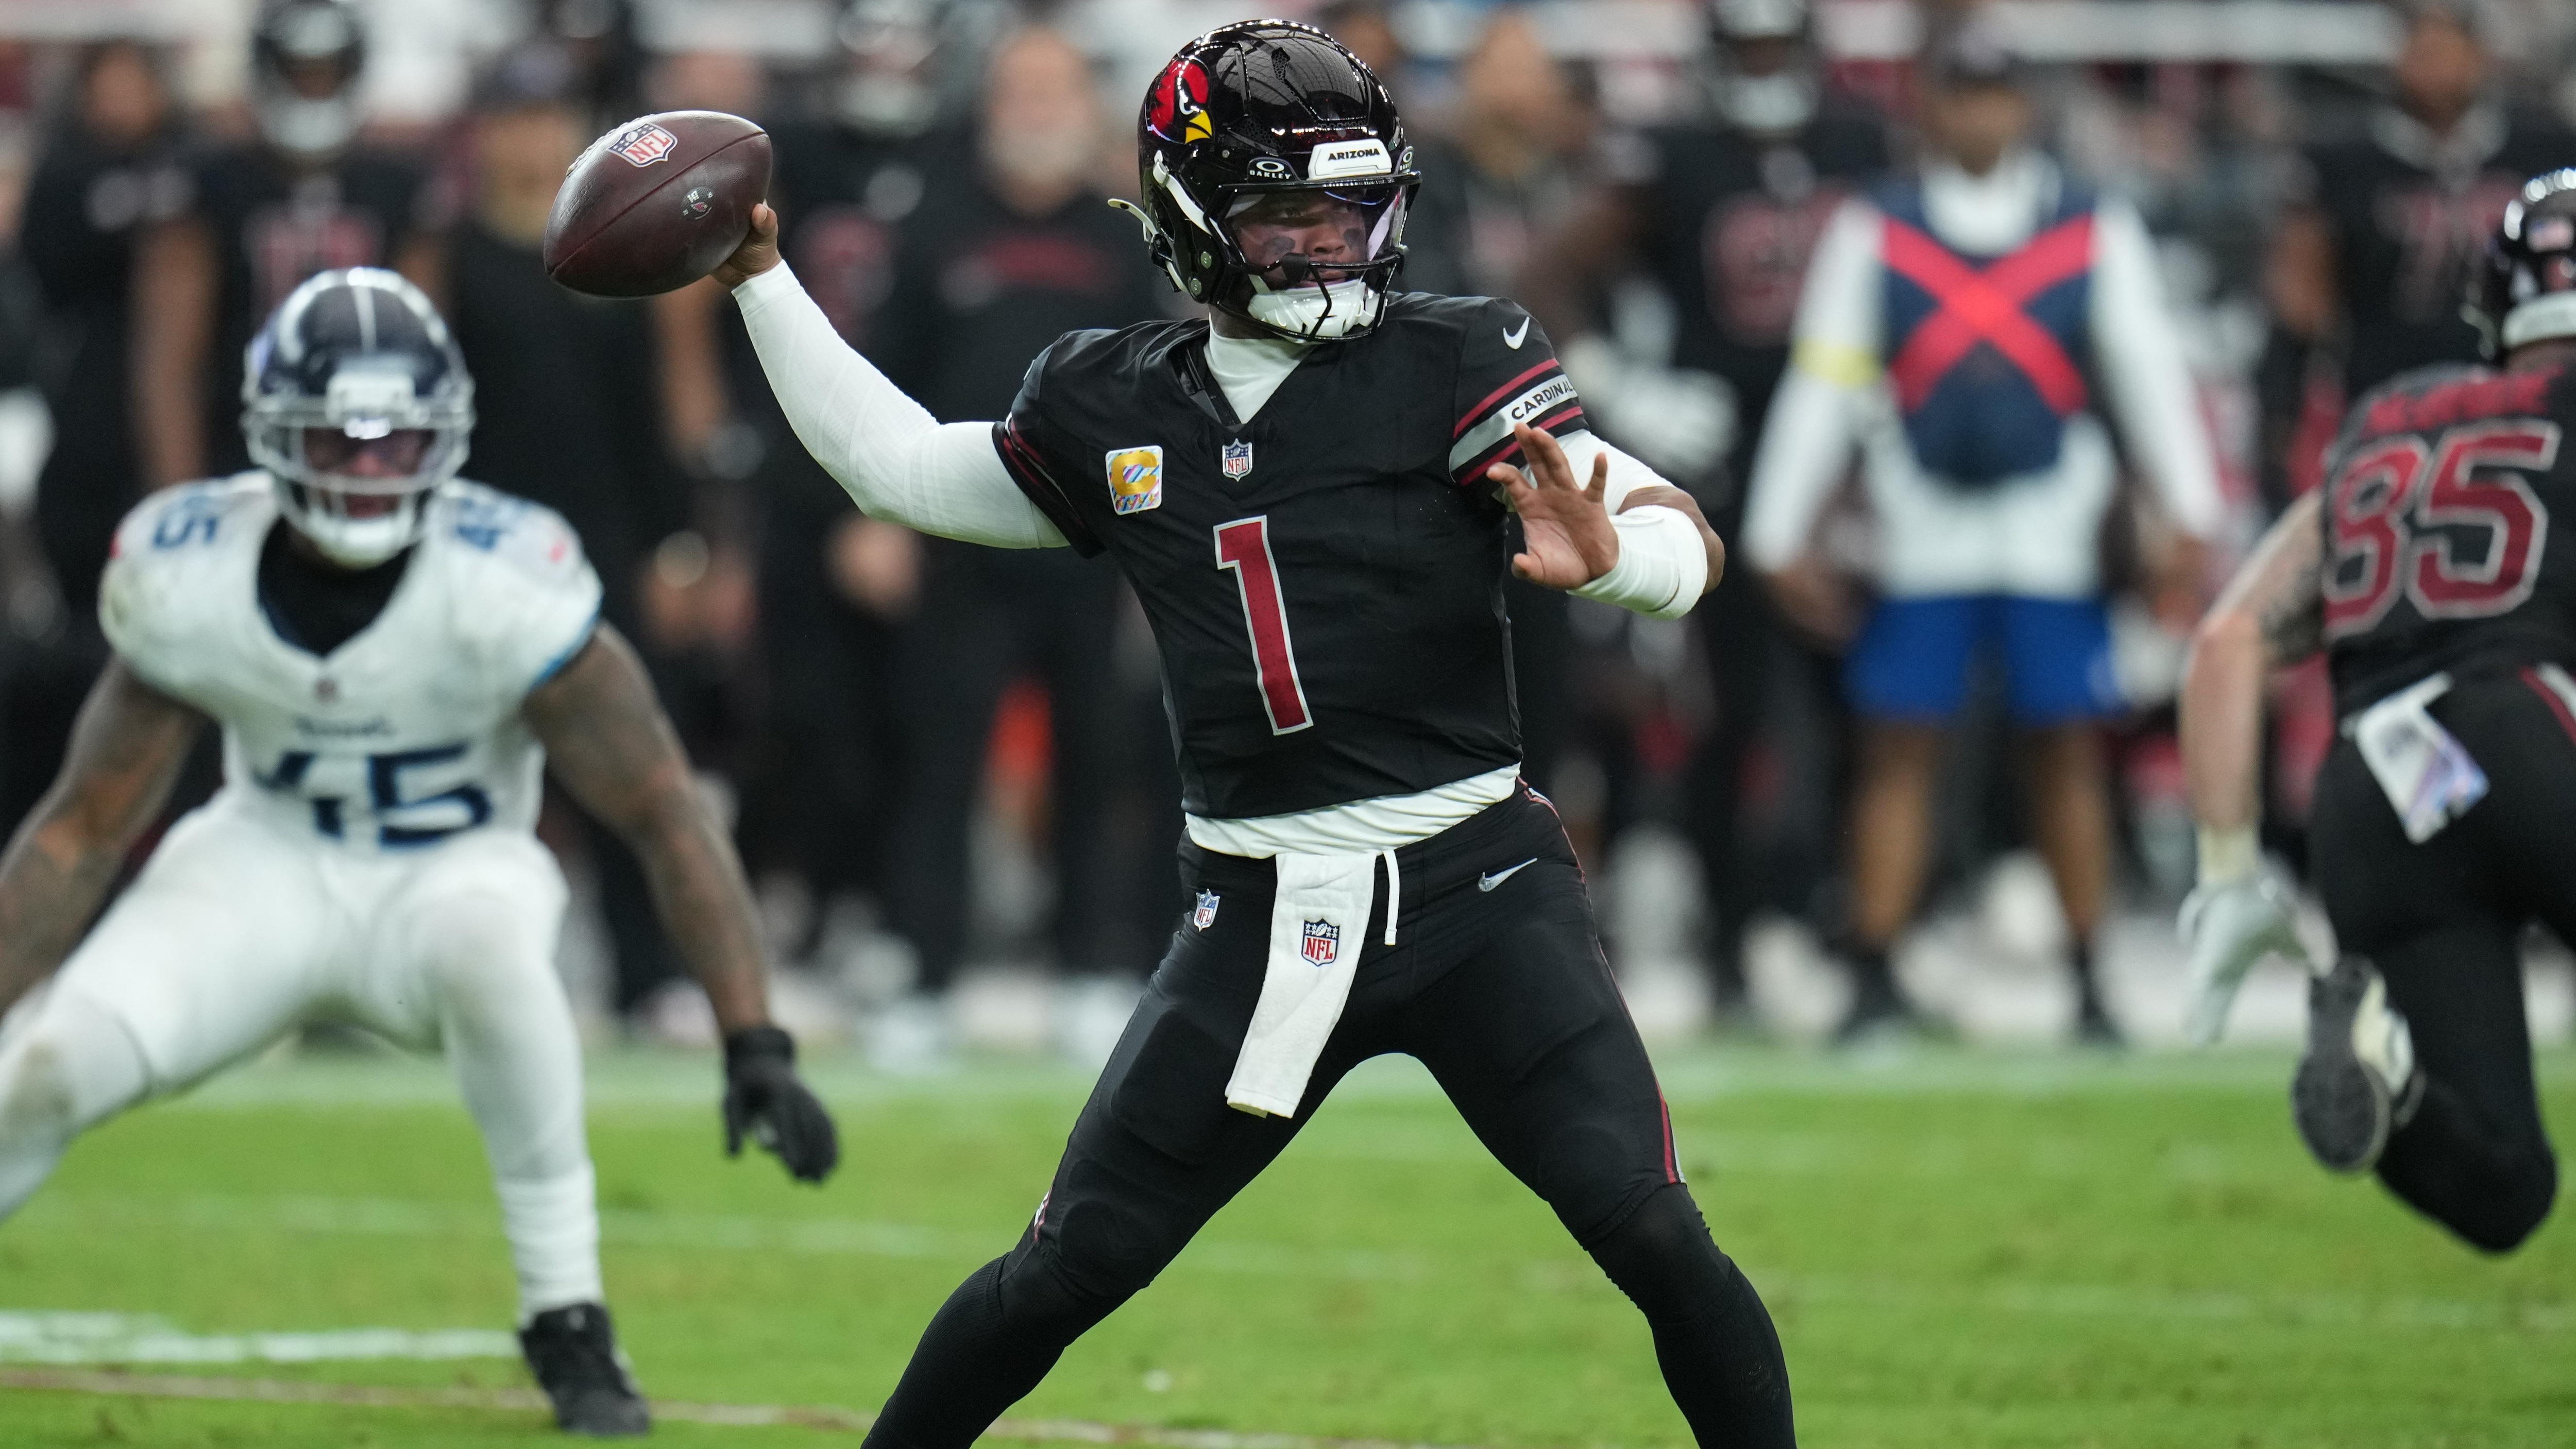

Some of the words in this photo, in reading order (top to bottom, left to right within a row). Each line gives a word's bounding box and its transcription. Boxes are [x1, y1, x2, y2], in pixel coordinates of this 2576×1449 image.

[626, 133, 670, 161] NFL
[1328, 148, 1380, 161] ARIZONA
[1249, 169, 1292, 180] OAKLEY
[1512, 380, 1574, 420] CARDINAL
[1111, 451, 1158, 496] C
[1227, 458, 1247, 473] NFL
[2321, 418, 2563, 642] 85
[1213, 515, 1314, 736] 1
[251, 740, 493, 851] 45
[1197, 908, 1211, 923] NFL
[1304, 936, 1333, 961] NFL
